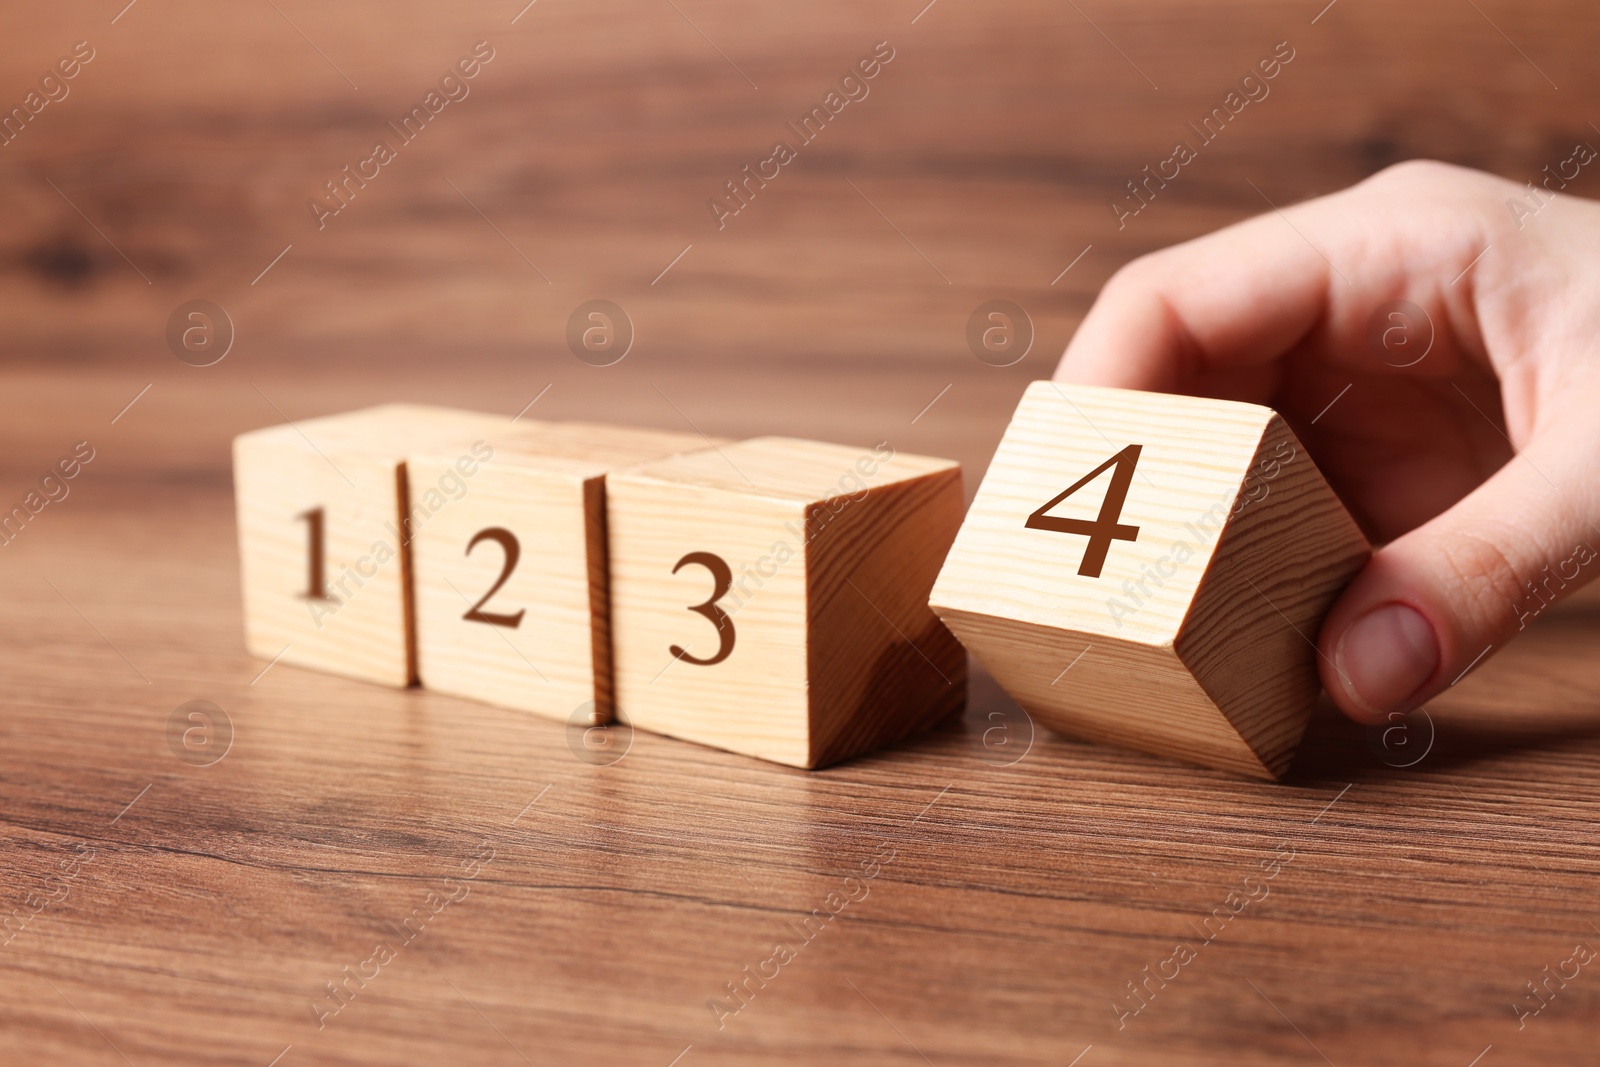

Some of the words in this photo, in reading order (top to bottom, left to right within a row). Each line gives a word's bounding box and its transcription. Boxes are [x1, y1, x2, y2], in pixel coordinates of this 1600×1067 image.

[294, 503, 332, 602] 1
[1024, 444, 1143, 578] 4
[462, 526, 526, 630] 2
[669, 551, 736, 666] 3
